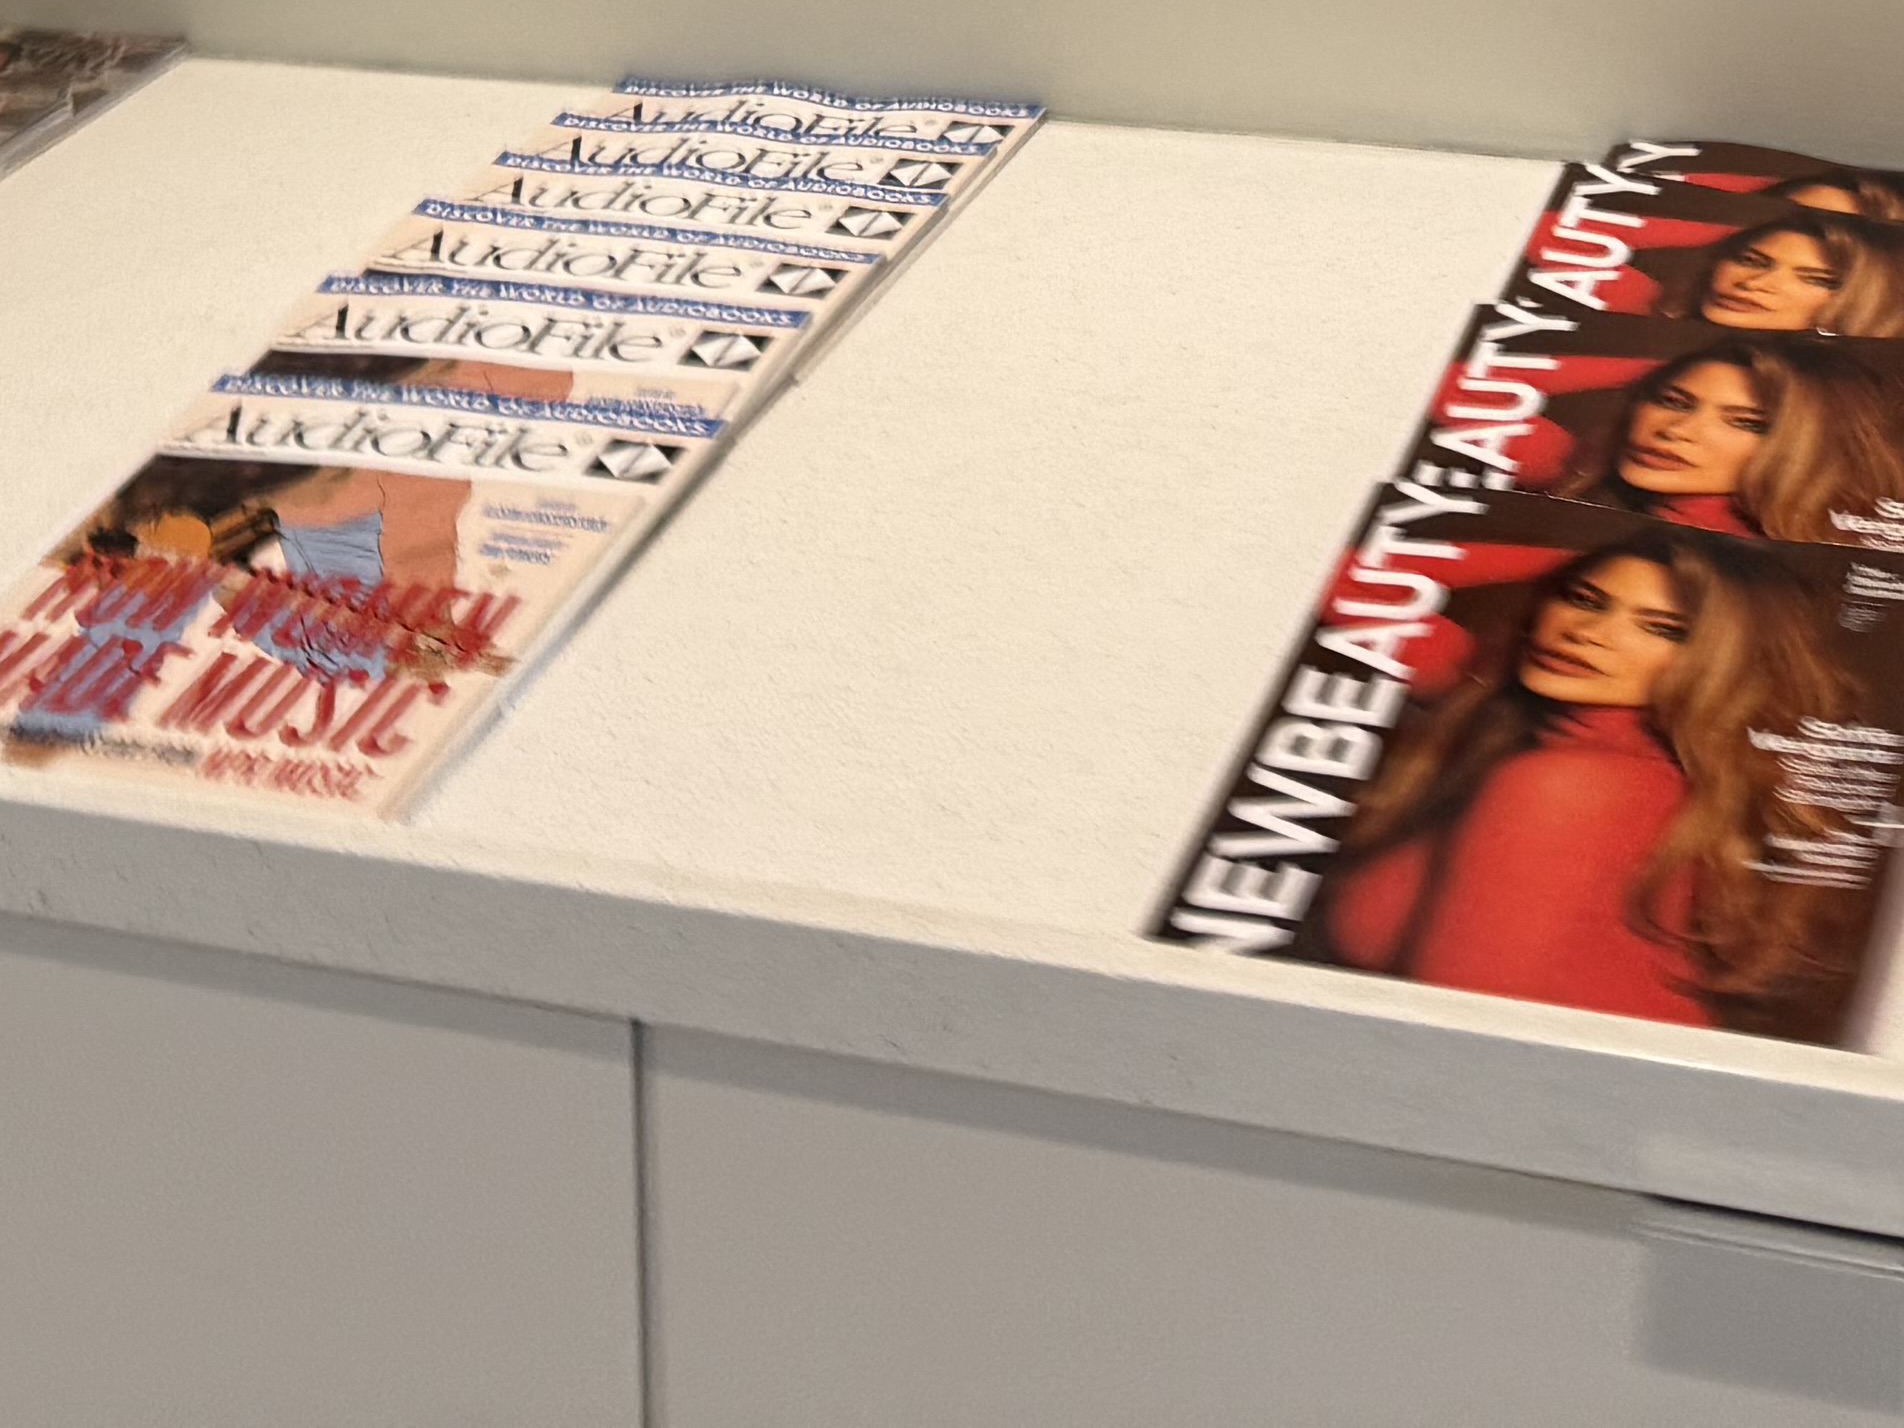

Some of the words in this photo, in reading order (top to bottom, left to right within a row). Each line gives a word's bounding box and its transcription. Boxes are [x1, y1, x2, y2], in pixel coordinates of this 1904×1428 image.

[536, 135, 864, 181] AudioFile
[564, 117, 667, 132] DISCOVER
[716, 122, 793, 141] WORLD
[832, 135, 980, 154] AUDIOBOOKS
[465, 174, 813, 229] AudioFile
[506, 157, 613, 175] DISCOVER
[662, 165, 742, 186] WORLD
[778, 180, 933, 204] AUDIOBOOKS
[380, 225, 742, 289] AudioFile
[285, 300, 664, 362] AudioFile
[175, 399, 568, 471] AudioFile
[157, 650, 451, 757] MUSIC
